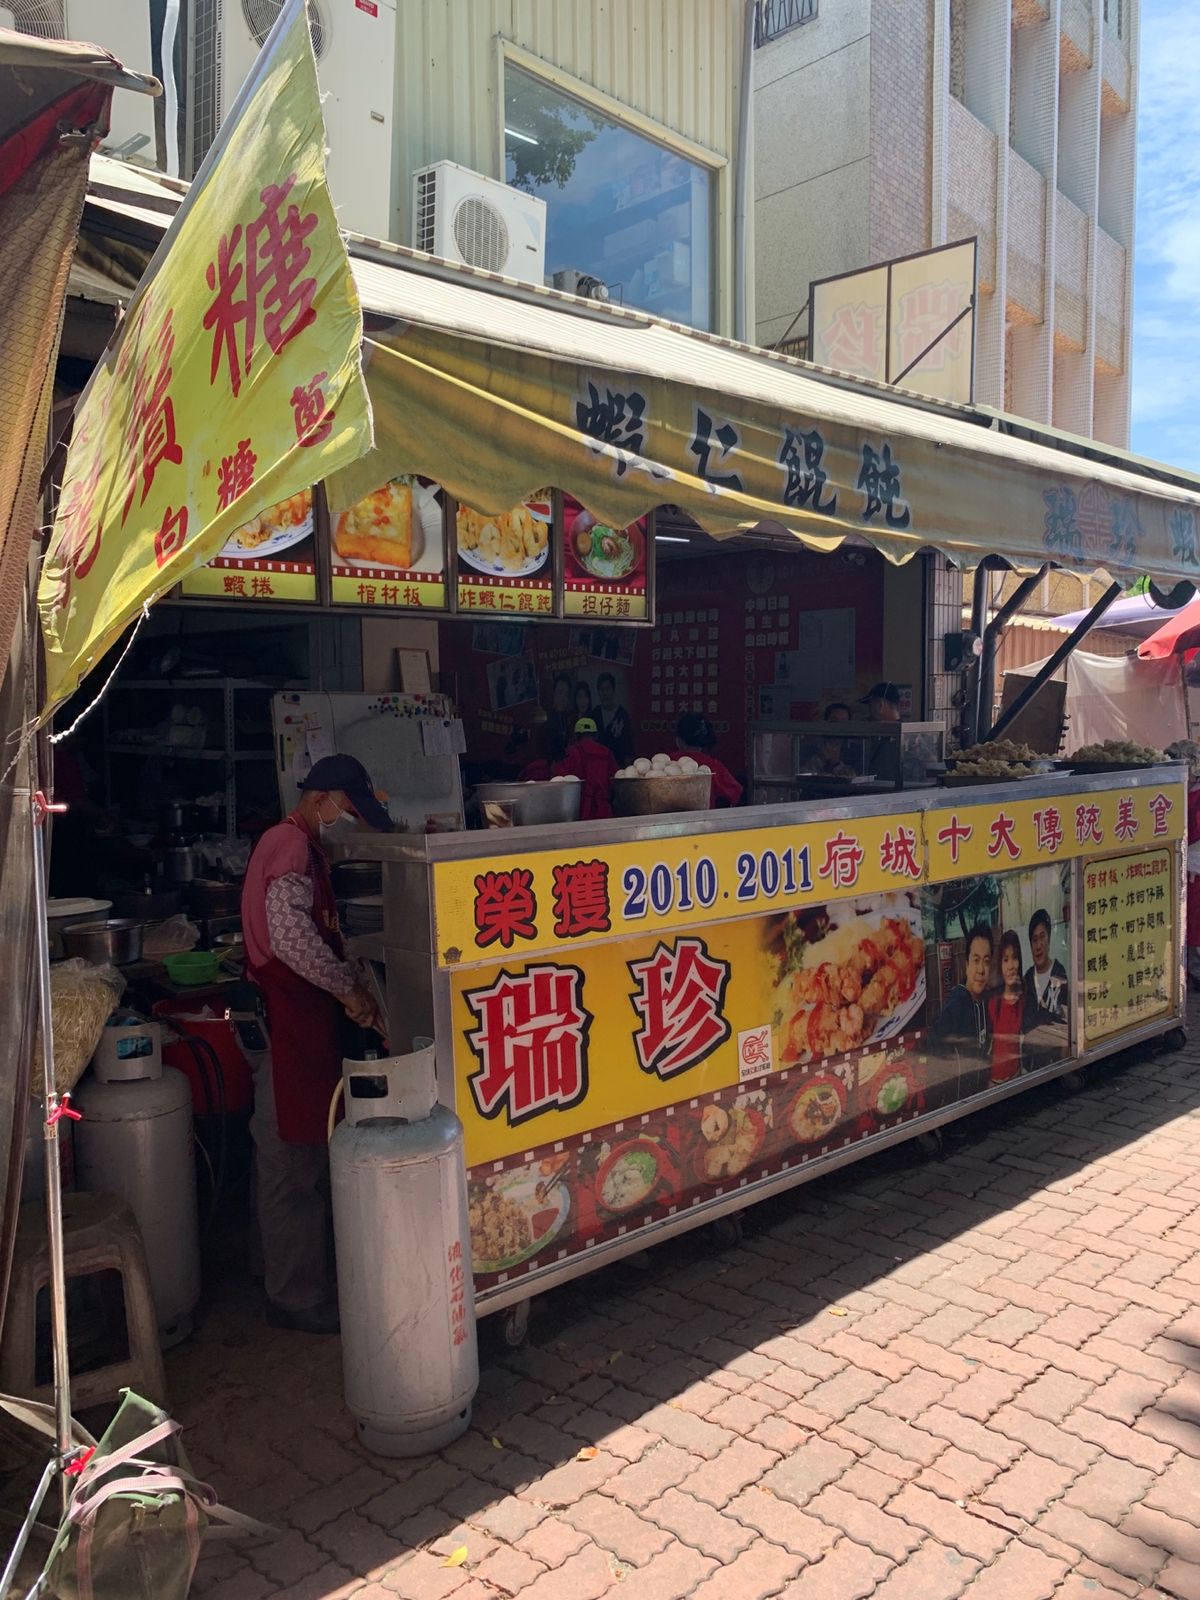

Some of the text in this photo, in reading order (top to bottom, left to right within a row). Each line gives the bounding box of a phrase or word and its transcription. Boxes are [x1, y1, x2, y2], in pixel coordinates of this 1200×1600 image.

[223, 575, 275, 597] 蝦捲
[357, 584, 424, 607] 棺材板
[459, 588, 552, 613] 炸蝦仁餛飩
[475, 859, 610, 948] 榮獲
[819, 793, 1172, 888] 府城十大傳統美食
[1087, 867, 1119, 888] 棺材板
[1086, 894, 1118, 916] 蚵仔煎
[1087, 922, 1118, 944] 蝦仁煎
[1087, 953, 1109, 972] 蝦捲
[461, 936, 732, 1128] 瑞珍
